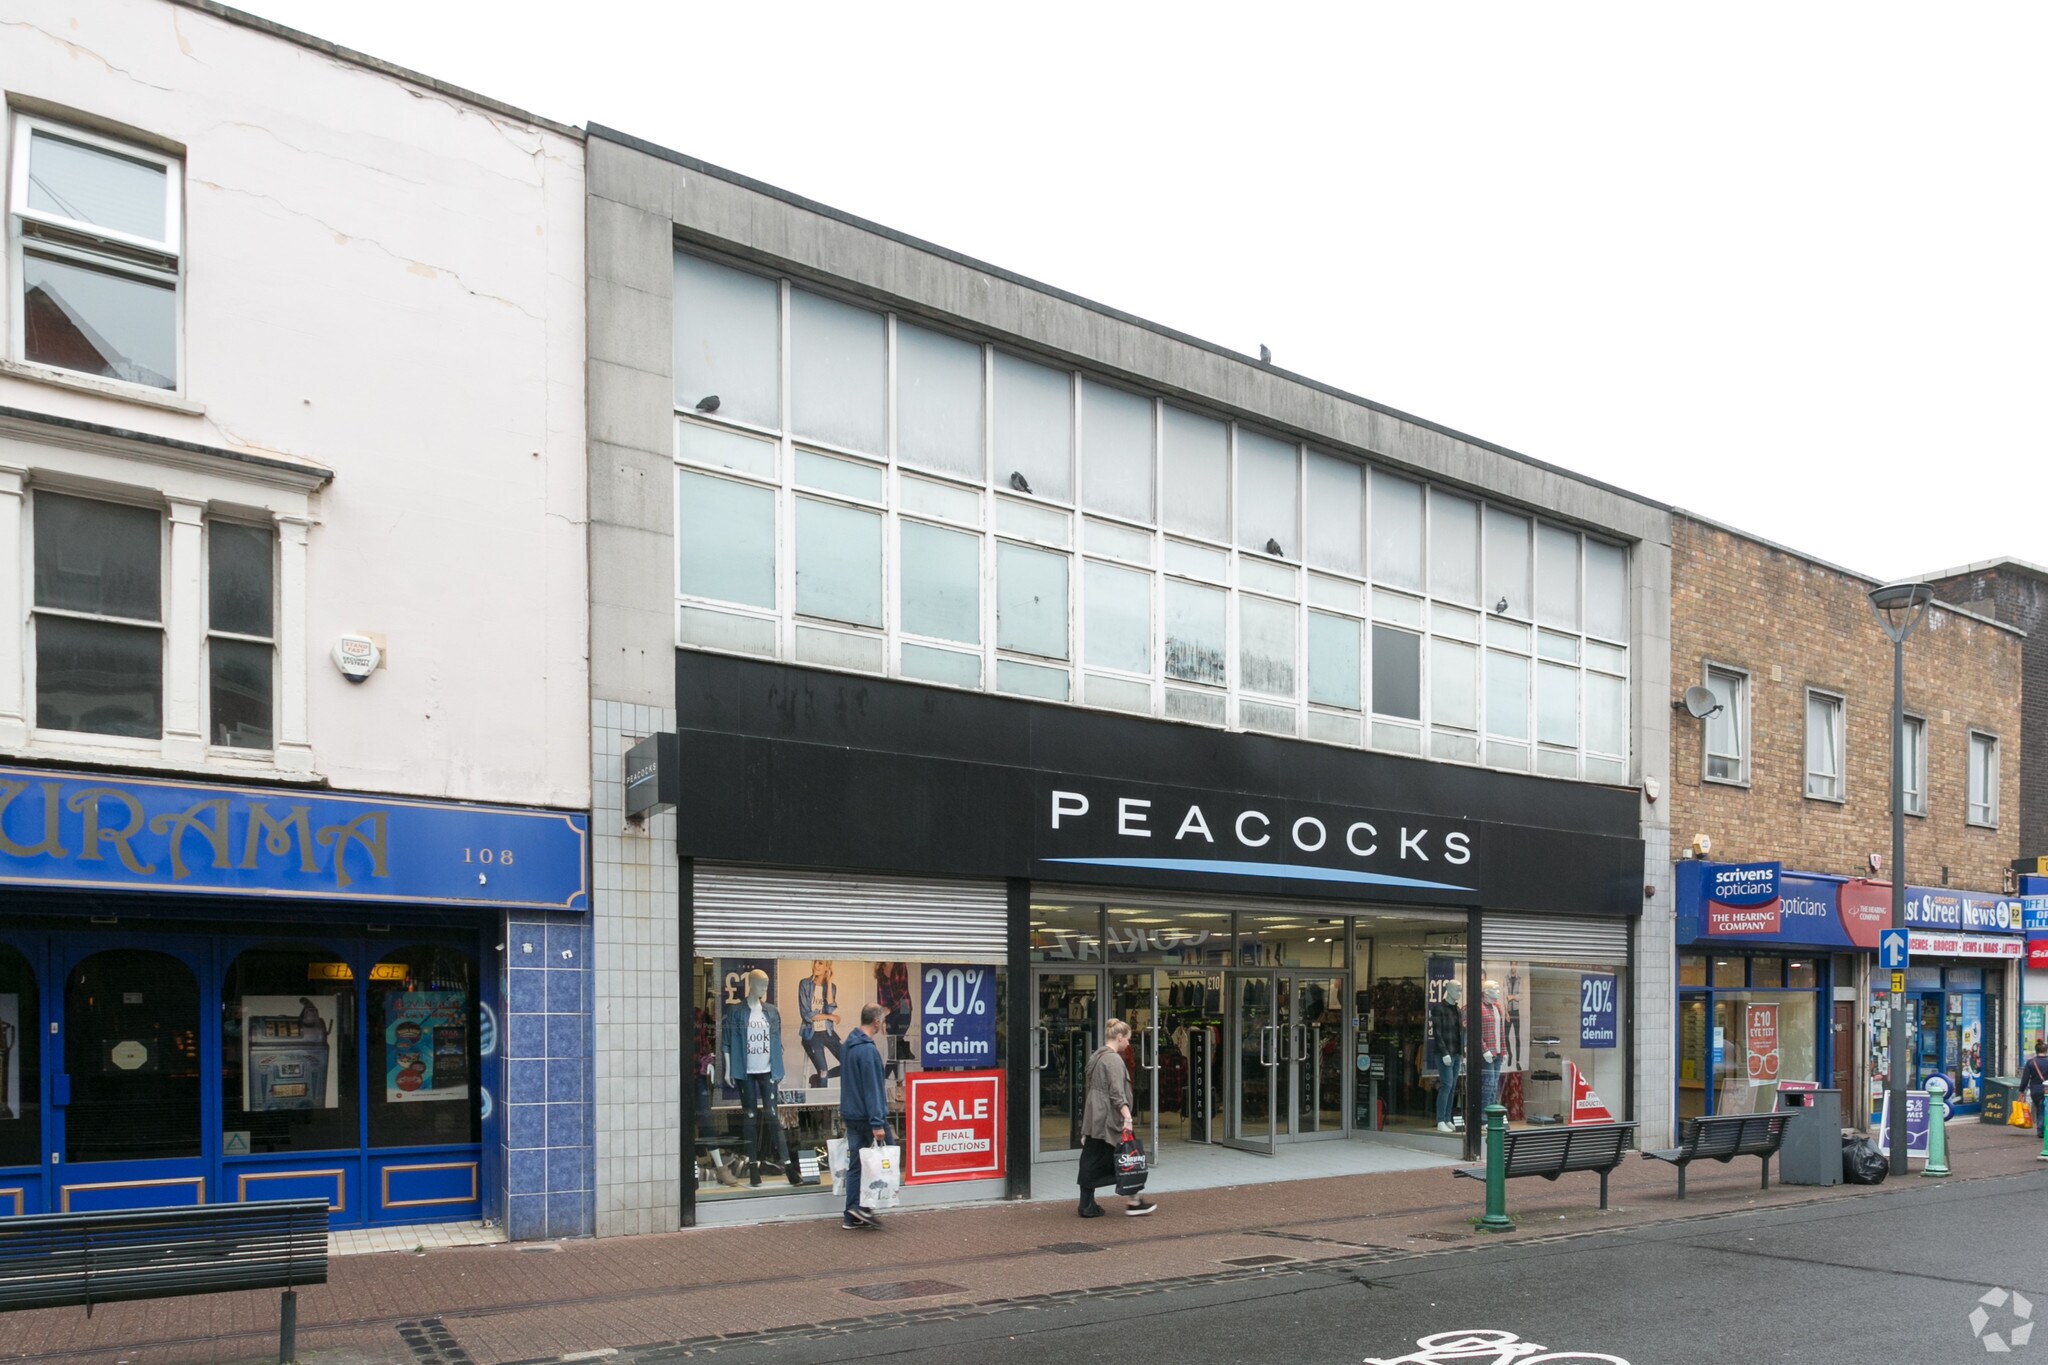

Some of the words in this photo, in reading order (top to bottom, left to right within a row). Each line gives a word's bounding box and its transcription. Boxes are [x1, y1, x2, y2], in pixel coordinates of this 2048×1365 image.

[626, 762, 657, 785] PEACOCKS
[1051, 789, 1472, 866] PEACOCKS
[463, 847, 514, 866] 108
[1715, 868, 1774, 882] scrivens
[1715, 881, 1773, 899] opticians
[1712, 913, 1730, 922] THE
[1732, 911, 1775, 922] HEARING
[1860, 904, 1868, 913] THE
[1868, 905, 1887, 914] HEARING
[1921, 894, 1960, 923] Street
[1963, 898, 1996, 927] News
[1860, 913, 1881, 921] COMPANY
[1719, 921, 1766, 931] COMPANY
[1933, 939, 1959, 952] GROCERY
[1962, 941, 1978, 953] NEWS
[1983, 942, 1999, 953] MAGS
[2001, 943, 2021, 954] LOTTERY
[1207, 976, 1220, 990] £10
[924, 968, 986, 1016] 20%
[1582, 979, 1613, 1013] 20%
[1582, 1014, 1598, 1027] off
[1753, 1010, 1771, 1027] £10
[925, 1017, 955, 1036] off
[1582, 1027, 1614, 1040] denim
[1750, 1028, 1762, 1037] EYE
[1762, 1028, 1775, 1037] TEST
[925, 1035, 989, 1055] denim
[922, 1098, 989, 1122] SALE
[941, 1131, 970, 1140] FINAL
[924, 1141, 986, 1153] REDUCTIONS
